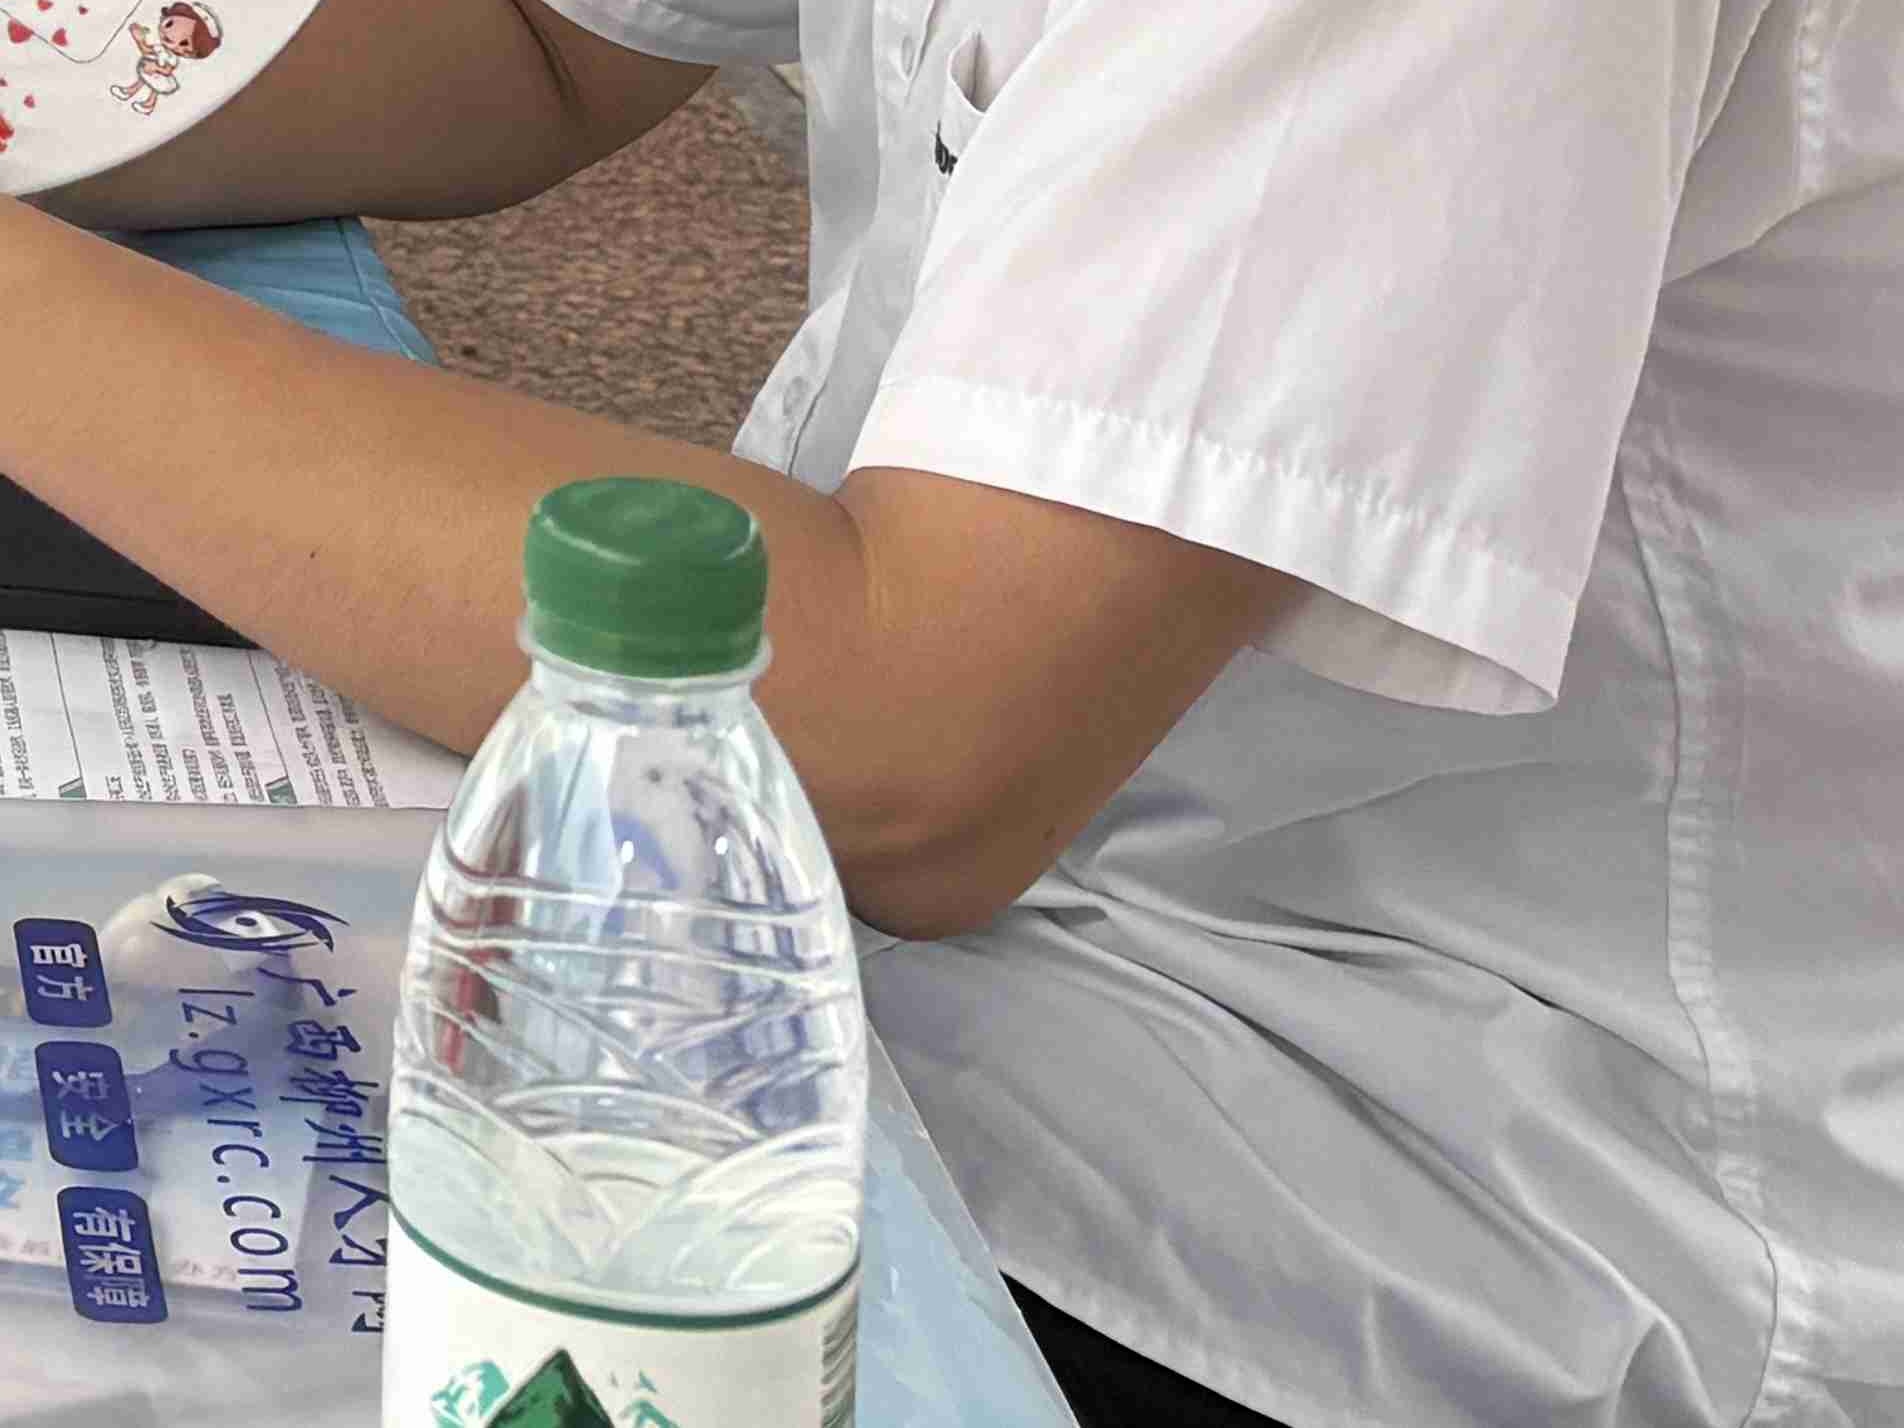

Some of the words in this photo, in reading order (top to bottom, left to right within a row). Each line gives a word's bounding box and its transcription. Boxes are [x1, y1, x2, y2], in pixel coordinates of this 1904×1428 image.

[28, 940, 93, 1002] 官方
[50, 1069, 112, 1142] 安全
[168, 986, 304, 1312] lz.gxrc.com
[72, 1207, 151, 1308] 有保障
